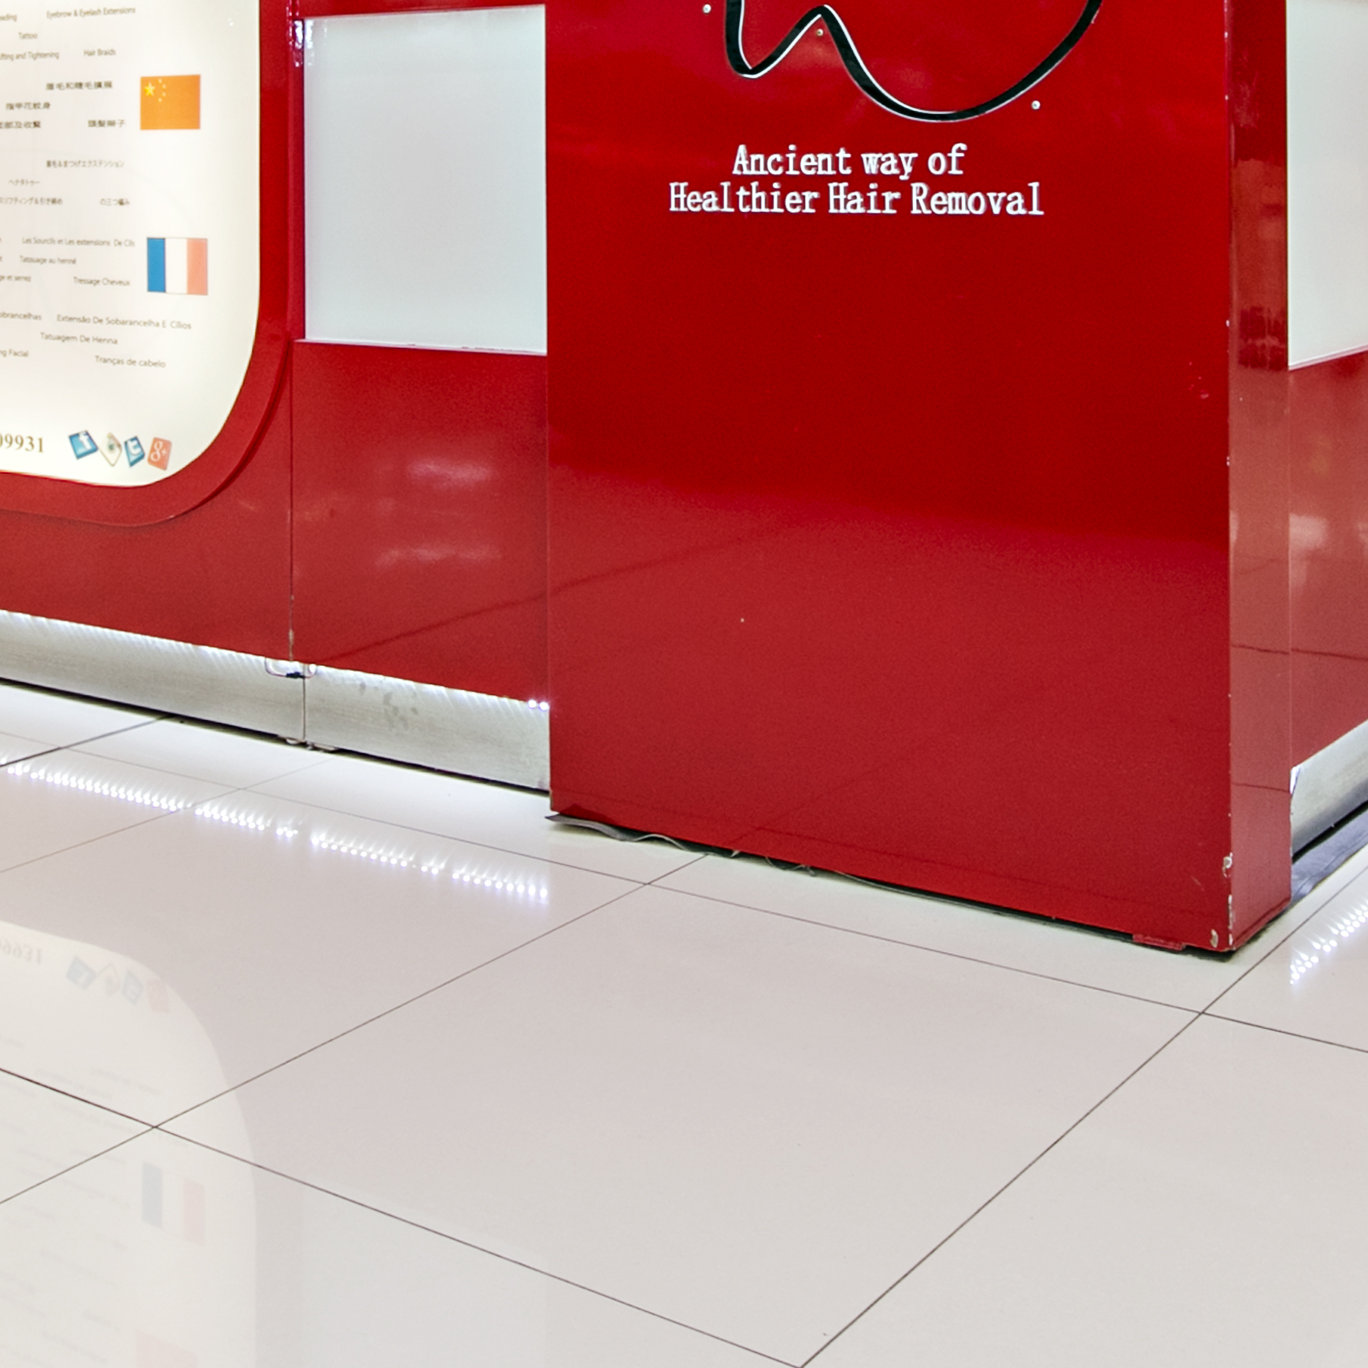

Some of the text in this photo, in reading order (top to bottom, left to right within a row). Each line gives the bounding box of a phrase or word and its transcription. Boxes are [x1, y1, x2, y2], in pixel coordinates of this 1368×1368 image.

[46, 10, 71, 20] Eyebrow
[103, 7, 136, 16] Extensions
[28, 51, 59, 60] Tightening
[732, 143, 967, 180] Ancient way of
[669, 181, 1045, 216] Healthier Hair Removal
[33, 237, 56, 245] Sourcils
[65, 238, 75, 246] Les
[76, 238, 111, 247] extensions
[114, 239, 122, 247] De
[19, 255, 47, 265] Tatouage
[73, 276, 130, 286] Tressage Cheveux
[57, 314, 90, 324] Extensão
[93, 316, 103, 324] De
[40, 332, 118, 345] Tatuagem De Henna
[9, 349, 29, 358] Facial
[126, 358, 136, 366] de
[139, 359, 166, 369] cabelo
